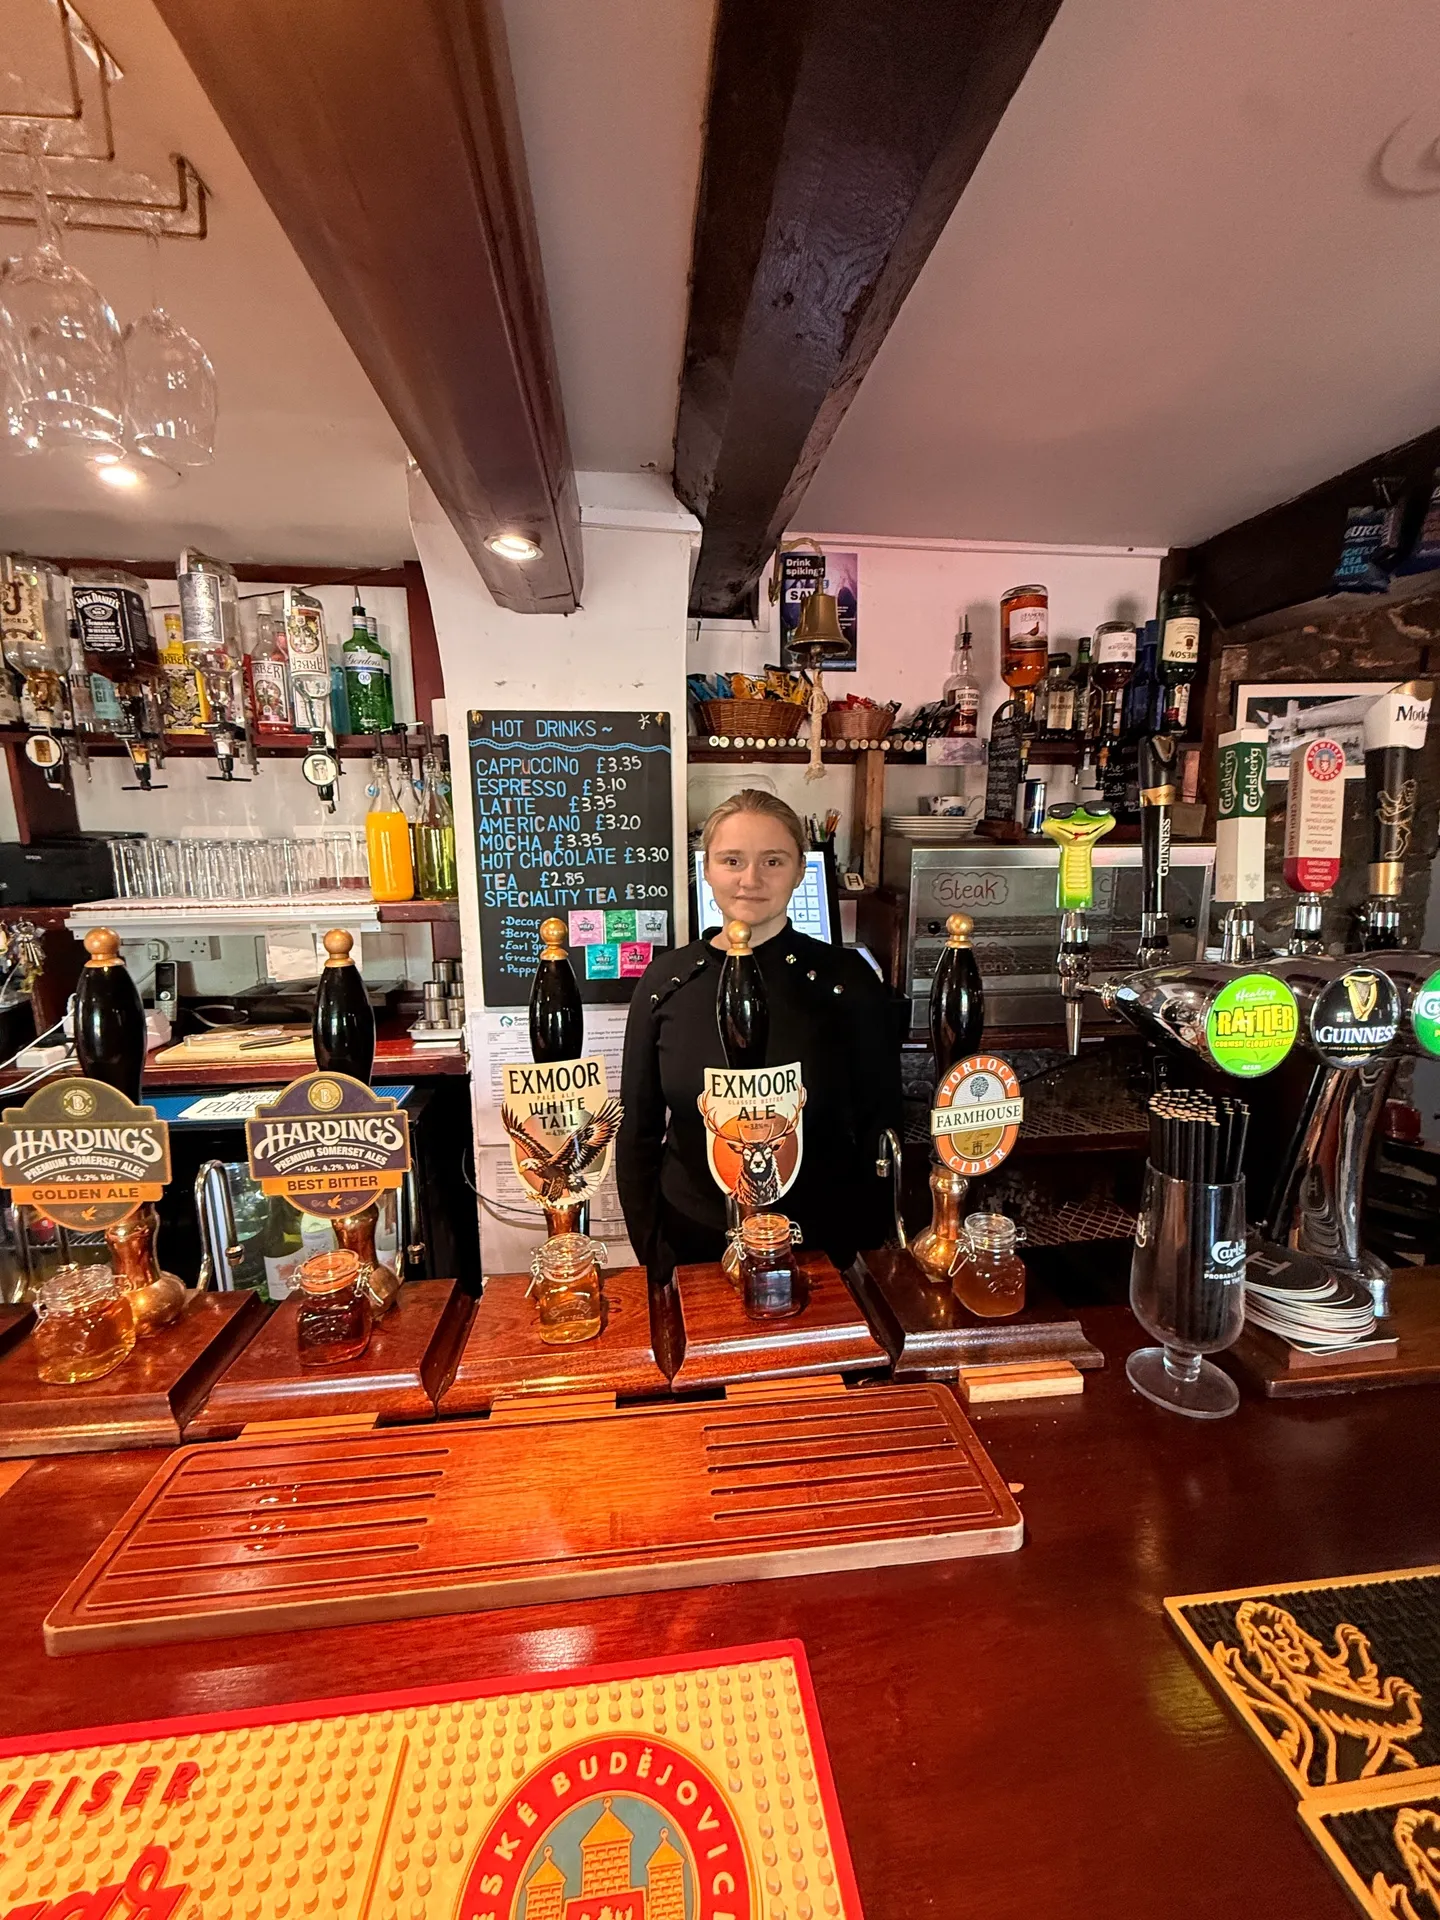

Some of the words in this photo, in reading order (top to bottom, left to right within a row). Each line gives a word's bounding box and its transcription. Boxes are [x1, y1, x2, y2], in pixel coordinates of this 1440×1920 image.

[786, 559, 811, 567] Drink
[786, 567, 825, 577] spiking?
[75, 597, 93, 609] JACK
[491, 720, 525, 738] HOT
[536, 719, 597, 738] DRINKS
[476, 755, 580, 776] CAPPUCCINO
[596, 755, 643, 774] £3.35
[477, 778, 568, 798] ESPRESSO
[1218, 750, 1238, 815] Carlsberg
[1243, 748, 1263, 813] Carlsberg
[479, 797, 537, 816] LATTE
[568, 794, 617, 813] £3.35
[478, 814, 581, 835] AMERICANO
[595, 813, 642, 831] £3.20
[480, 834, 543, 852] MOCHA
[553, 832, 603, 851] £3.35
[1156, 818, 1172, 877] GUINNESS
[481, 852, 515, 870] HOT
[519, 847, 618, 869] CHOCOLATE
[623, 846, 670, 864] £3.30
[481, 873, 519, 891] TEA
[539, 871, 586, 889] £2.85
[939, 878, 999, 901] Steak
[484, 889, 581, 908] SPECIALITY
[585, 886, 618, 905] TEA
[624, 883, 669, 900] £3.00
[505, 916, 542, 930] Decaf
[504, 928, 540, 944] Berry
[505, 940, 528, 951] Earl
[504, 952, 540, 964] Green
[507, 964, 538, 978] Peppe
[1215, 1003, 1294, 1038] RATTLER
[1245, 1039, 1273, 1048] CLOUDY
[508, 1062, 602, 1095] EXMOOR
[711, 1069, 797, 1099] EXMOOR
[940, 1057, 1018, 1097] PORLOCK
[528, 1097, 586, 1116] WHITE
[760, 1096, 784, 1104] BITTER
[538, 1114, 579, 1129] TAIL
[737, 1104, 777, 1121] ALE
[936, 1104, 1021, 1129] FARMHOUSE
[2, 1127, 163, 1168] HARDINGS
[254, 1117, 404, 1160] HARDINGS
[24, 1157, 68, 1181] PREMIUM
[69, 1155, 120, 1169] SOMERSET
[120, 1161, 147, 1179] ALES
[273, 1148, 316, 1173] PREMIUM
[316, 1145, 364, 1157] SOMERSET
[365, 1151, 388, 1166] ALES
[304, 1164, 321, 1173] Alc.
[322, 1163, 345, 1172] 4.2%
[346, 1162, 360, 1171] Vol
[948, 1148, 1006, 1174] CIDER
[56, 1174, 74, 1182] Alc.
[75, 1174, 99, 1182] 4.2%
[101, 1173, 115, 1181] Vol
[287, 1179, 324, 1191] BEST
[327, 1176, 379, 1189] BITTER
[32, 1188, 101, 1201] GOLDEN
[107, 1187, 140, 1199] ALE
[1203, 1271, 1237, 1280] PROBABLY
